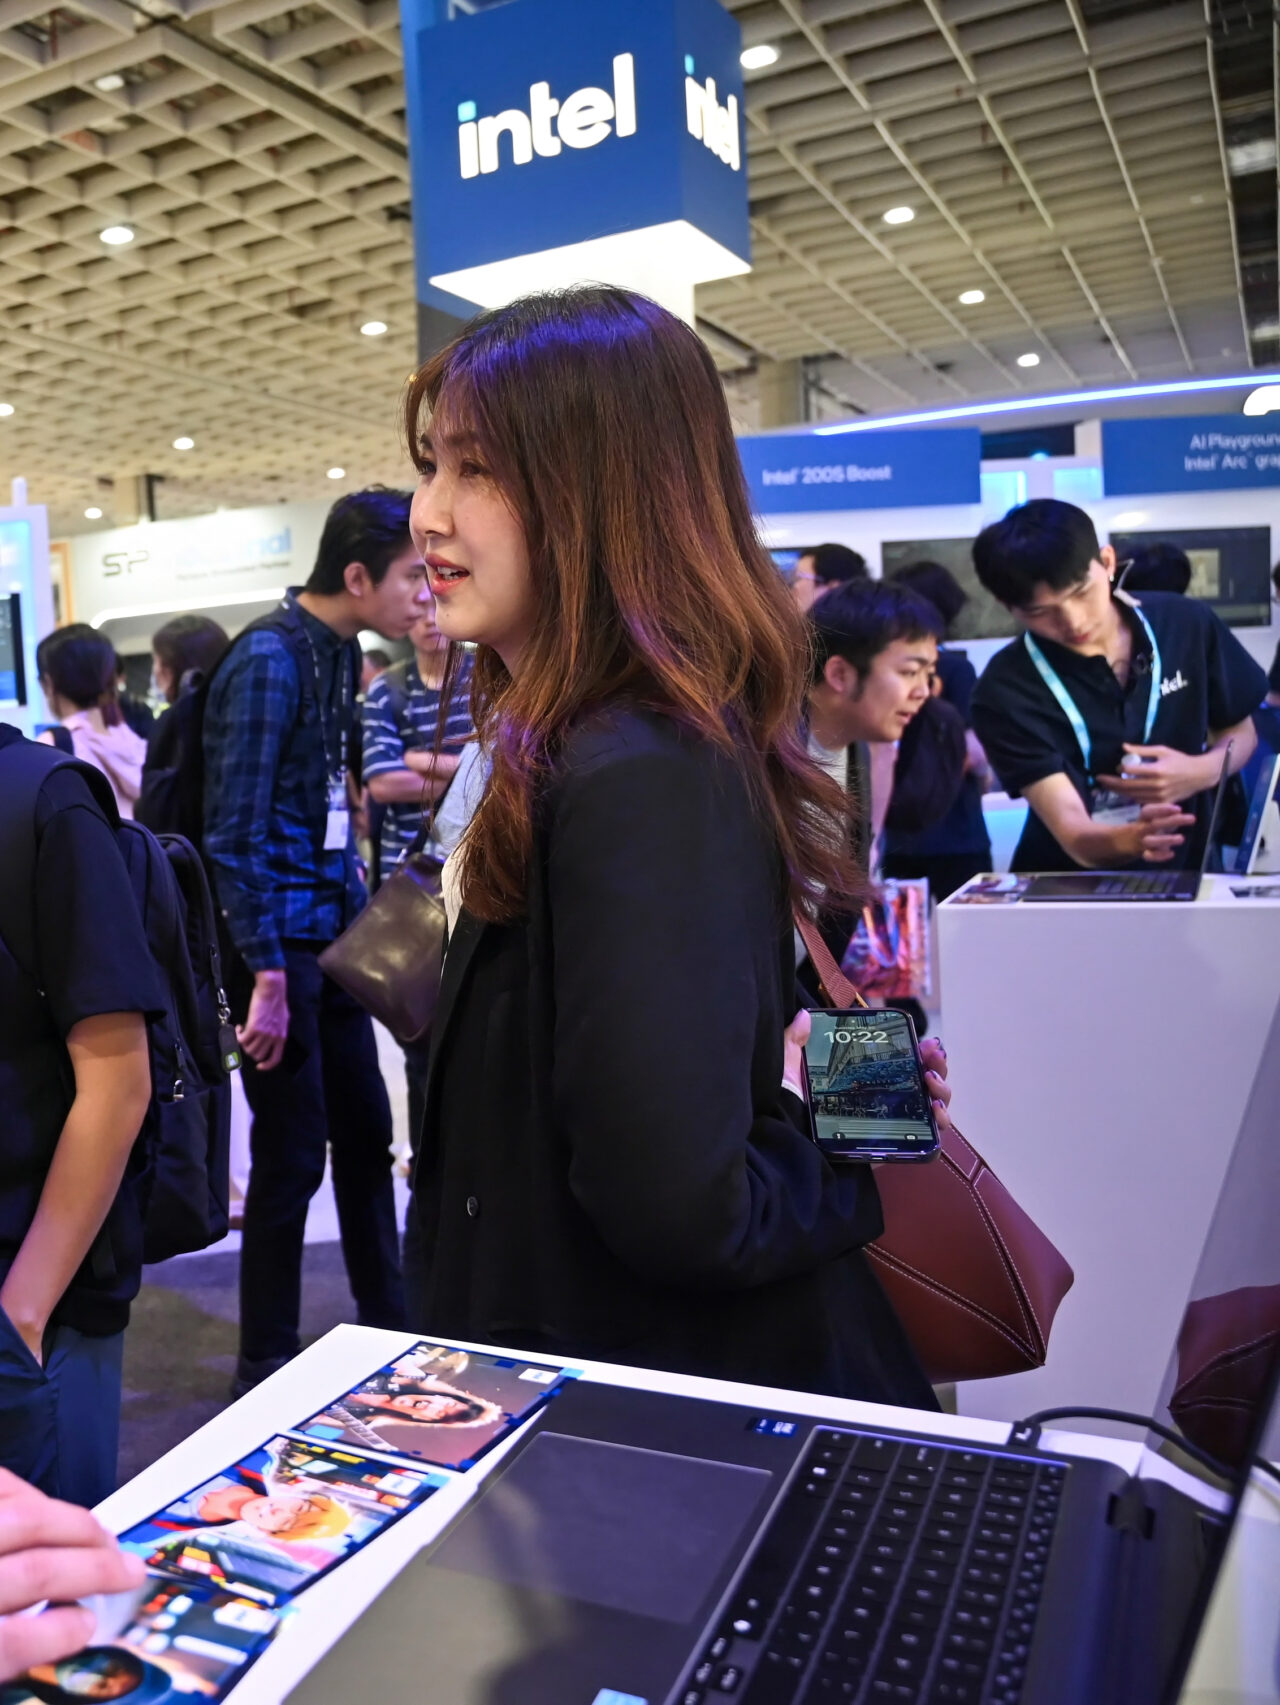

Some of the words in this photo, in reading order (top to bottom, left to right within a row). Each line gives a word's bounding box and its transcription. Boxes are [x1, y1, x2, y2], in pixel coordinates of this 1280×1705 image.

[458, 52, 637, 179] intel
[1190, 434, 1207, 450] AI
[1208, 433, 1280, 451] Playgroun
[823, 1030, 889, 1044] 10:22
